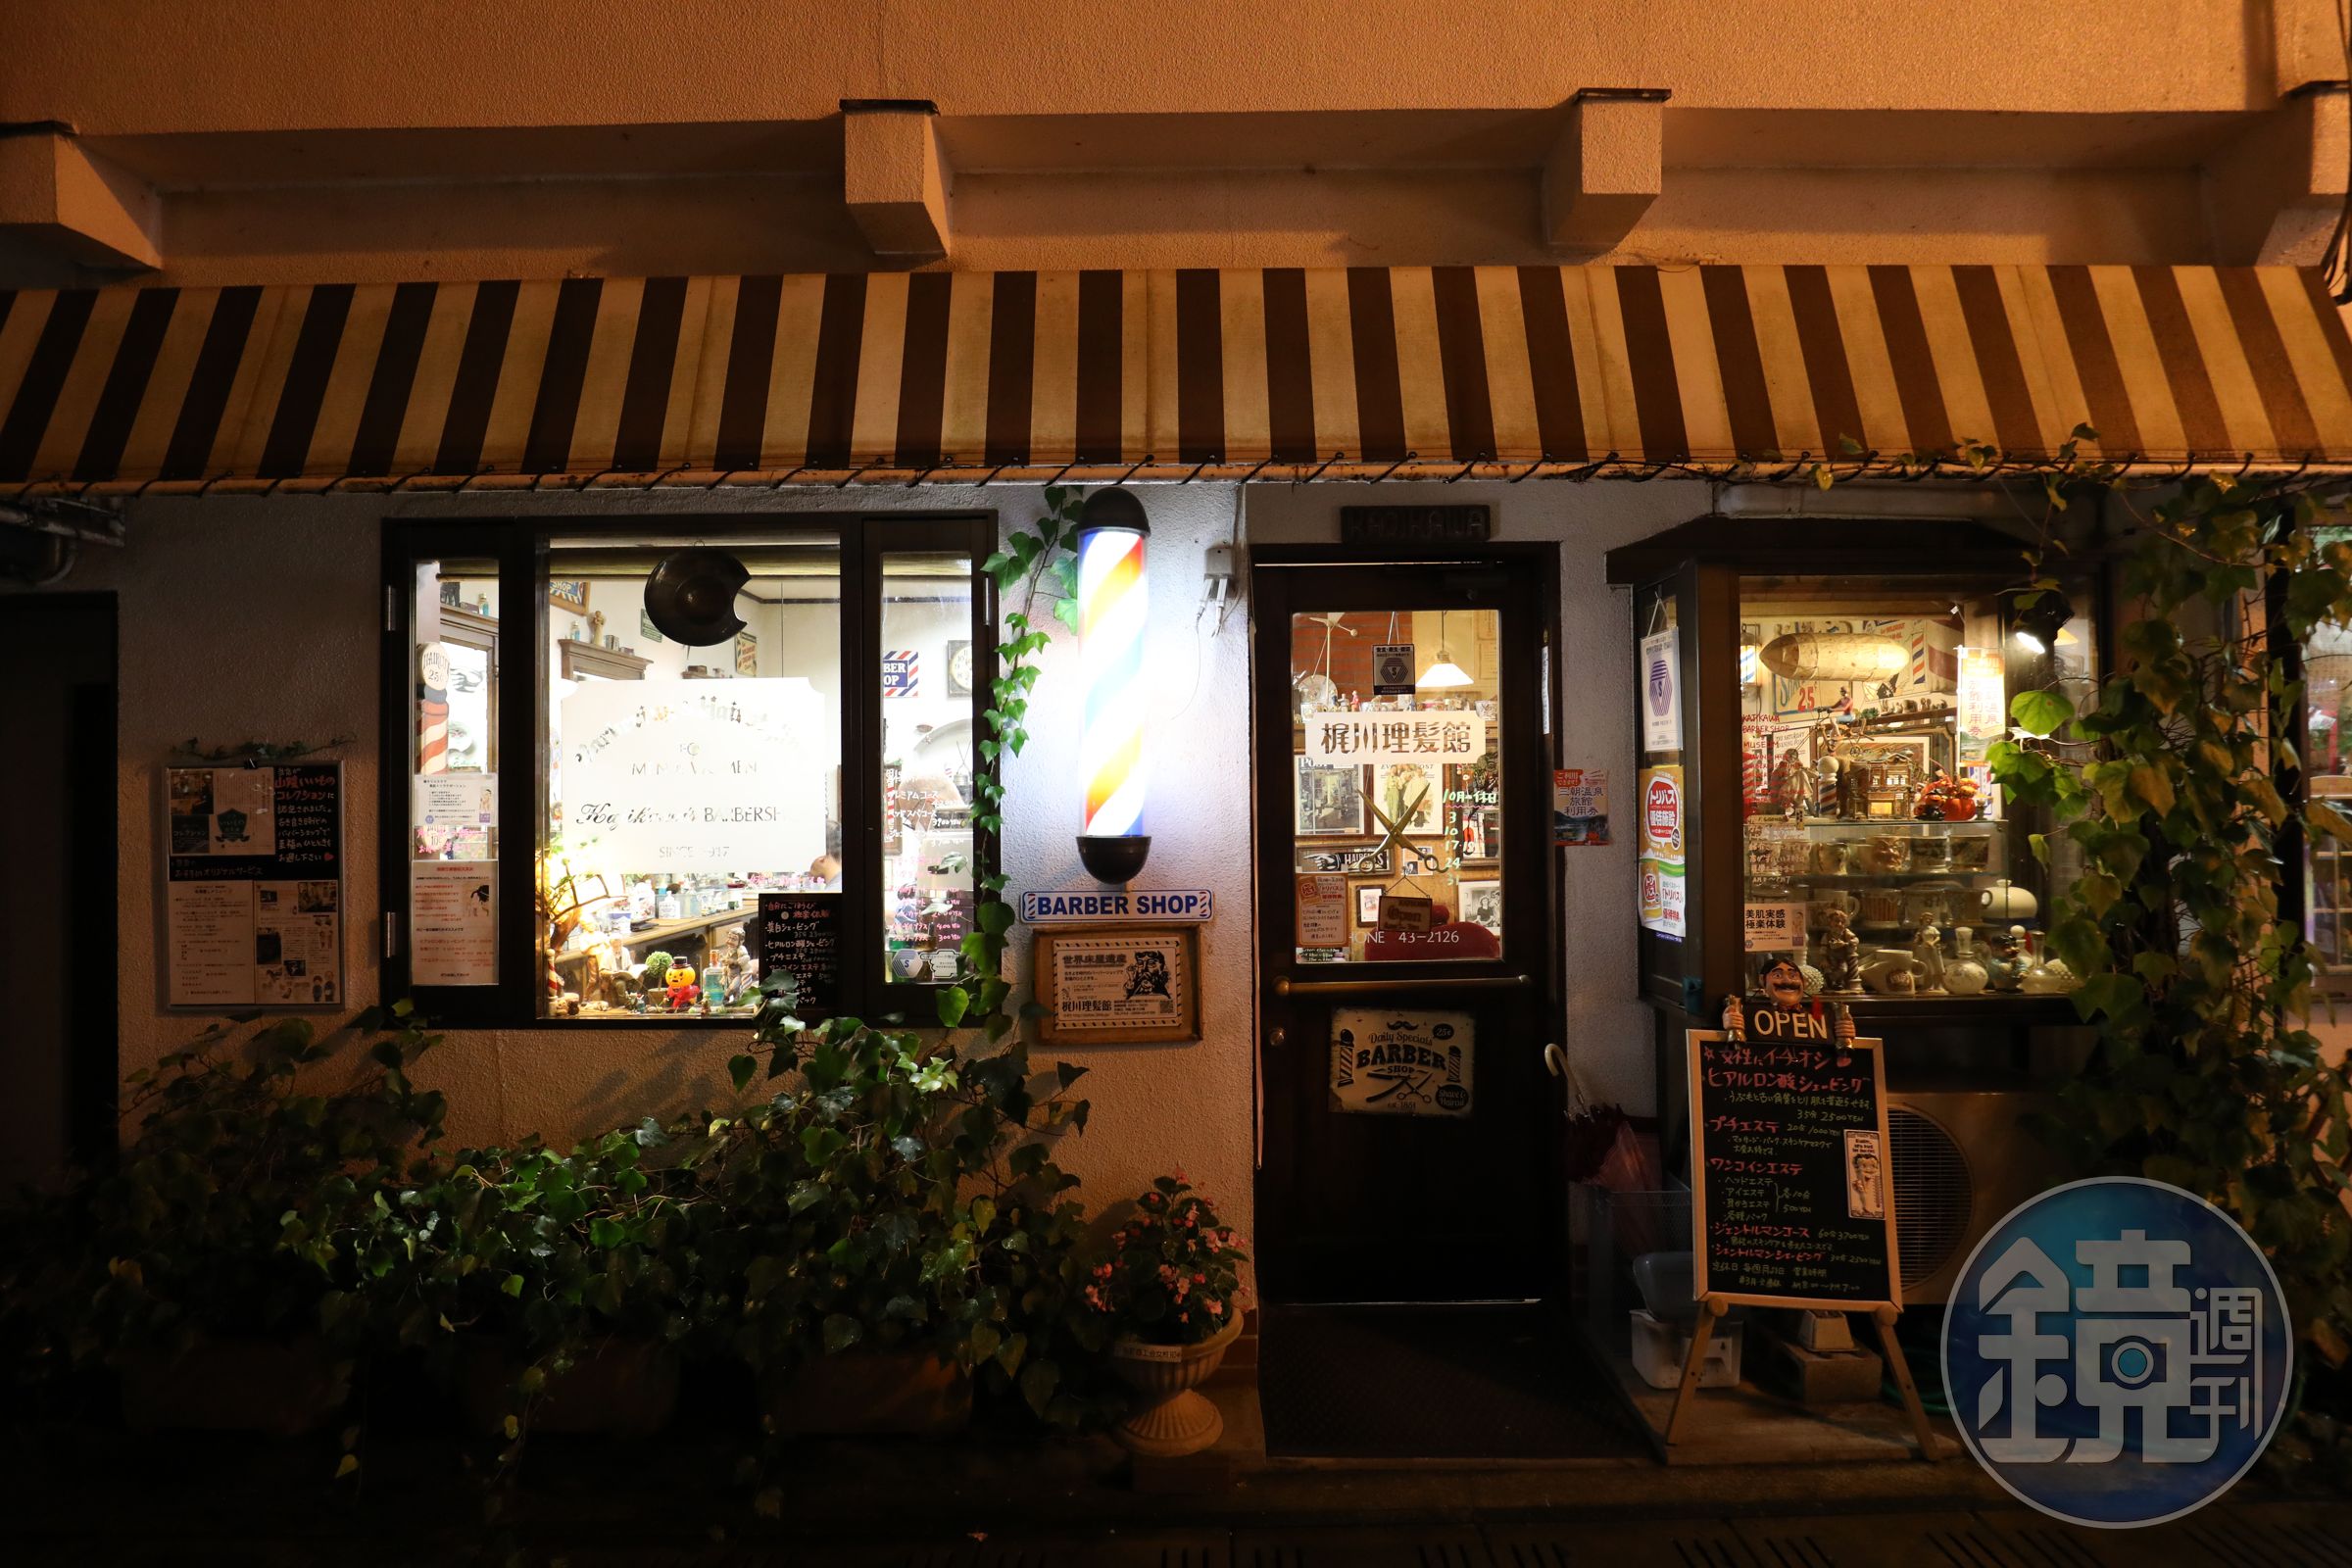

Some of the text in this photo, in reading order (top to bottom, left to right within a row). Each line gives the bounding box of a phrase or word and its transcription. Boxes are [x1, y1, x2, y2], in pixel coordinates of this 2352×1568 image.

[1321, 721, 1472, 755] 梶川理髪館
[1558, 787, 1604, 796] 三朝温泉
[1569, 797, 1593, 807] 旅館
[1448, 811, 1457, 824] 3
[1564, 807, 1599, 816] 利用券
[1444, 826, 1459, 836] 10
[1037, 895, 1199, 917] BARBER SHOP
[1745, 908, 1786, 919] 美肌実感
[1745, 919, 1787, 929] 極楽体験
[1061, 1000, 1112, 1012] 梶川理髪館
[1753, 1009, 1828, 1040] OPEN
[1355, 1044, 1447, 1071] BARBER
[1386, 1065, 1415, 1075] SHOP
[1709, 1115, 1781, 1134] プチエステ
[1709, 1157, 1804, 1177] ワンコインエステ
